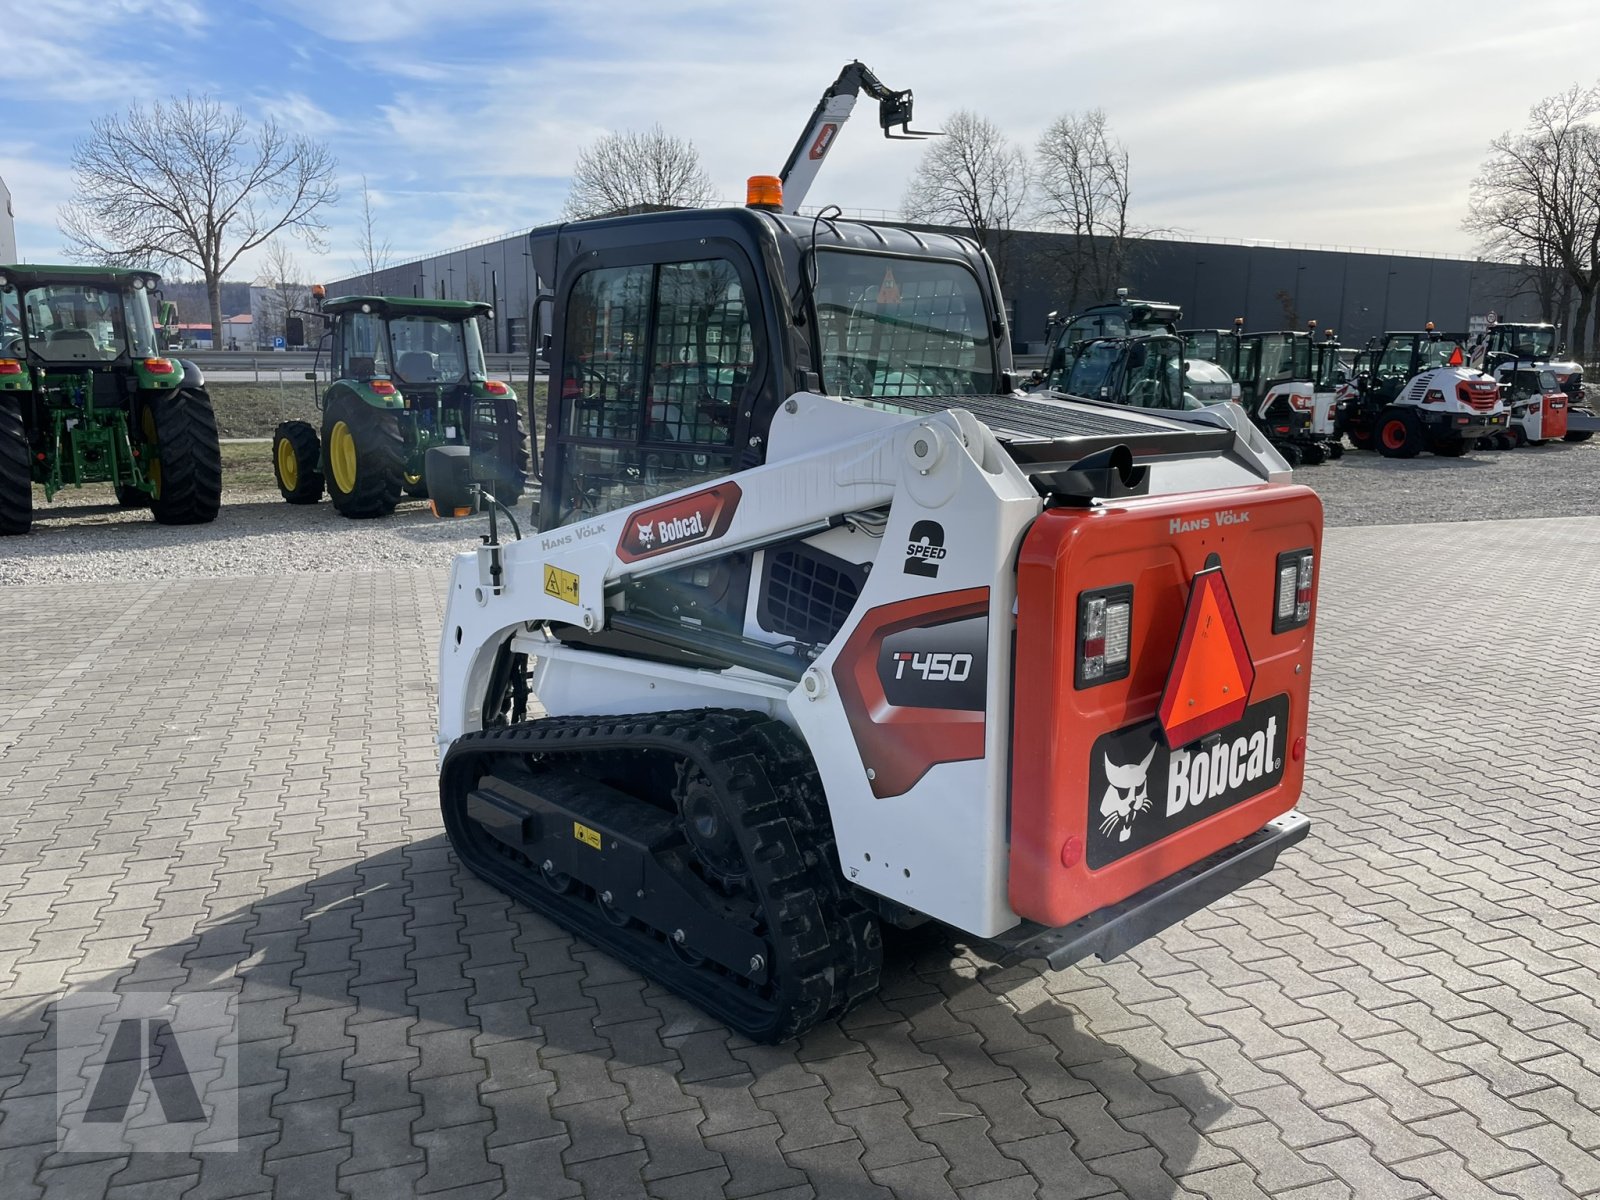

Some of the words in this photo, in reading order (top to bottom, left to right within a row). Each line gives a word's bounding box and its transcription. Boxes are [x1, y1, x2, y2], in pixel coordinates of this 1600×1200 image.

[275, 338, 282, 347] P
[658, 511, 704, 544] Bobcat
[903, 519, 945, 578] 2
[906, 544, 947, 560] SPEED
[893, 652, 973, 682] T450
[1166, 715, 1277, 817] Bobcat
